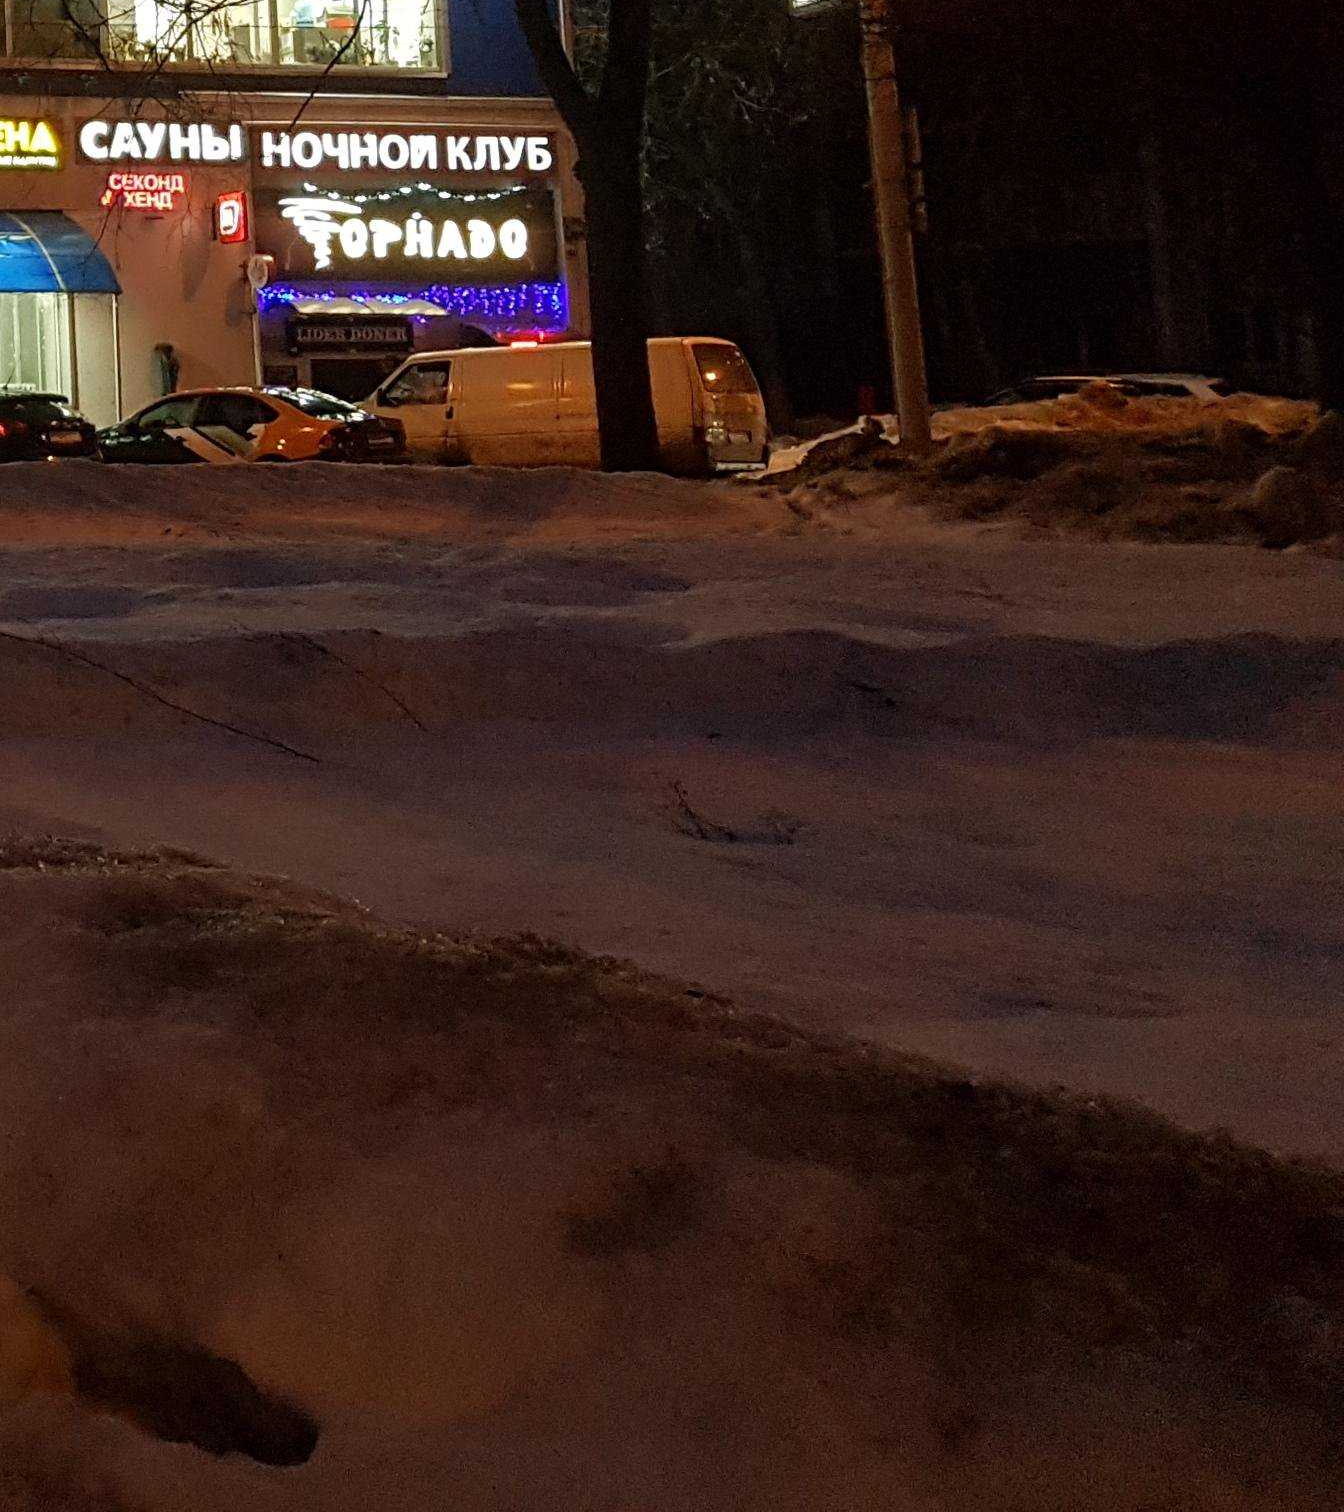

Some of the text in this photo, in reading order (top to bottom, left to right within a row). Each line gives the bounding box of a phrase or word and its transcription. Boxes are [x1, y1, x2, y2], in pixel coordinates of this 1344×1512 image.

[79, 120, 244, 162] САУНЫ
[261, 130, 553, 172] НОЧНОЙ КЛУБ
[108, 173, 184, 194] СЕКОНД
[123, 190, 174, 211] ХЕНД
